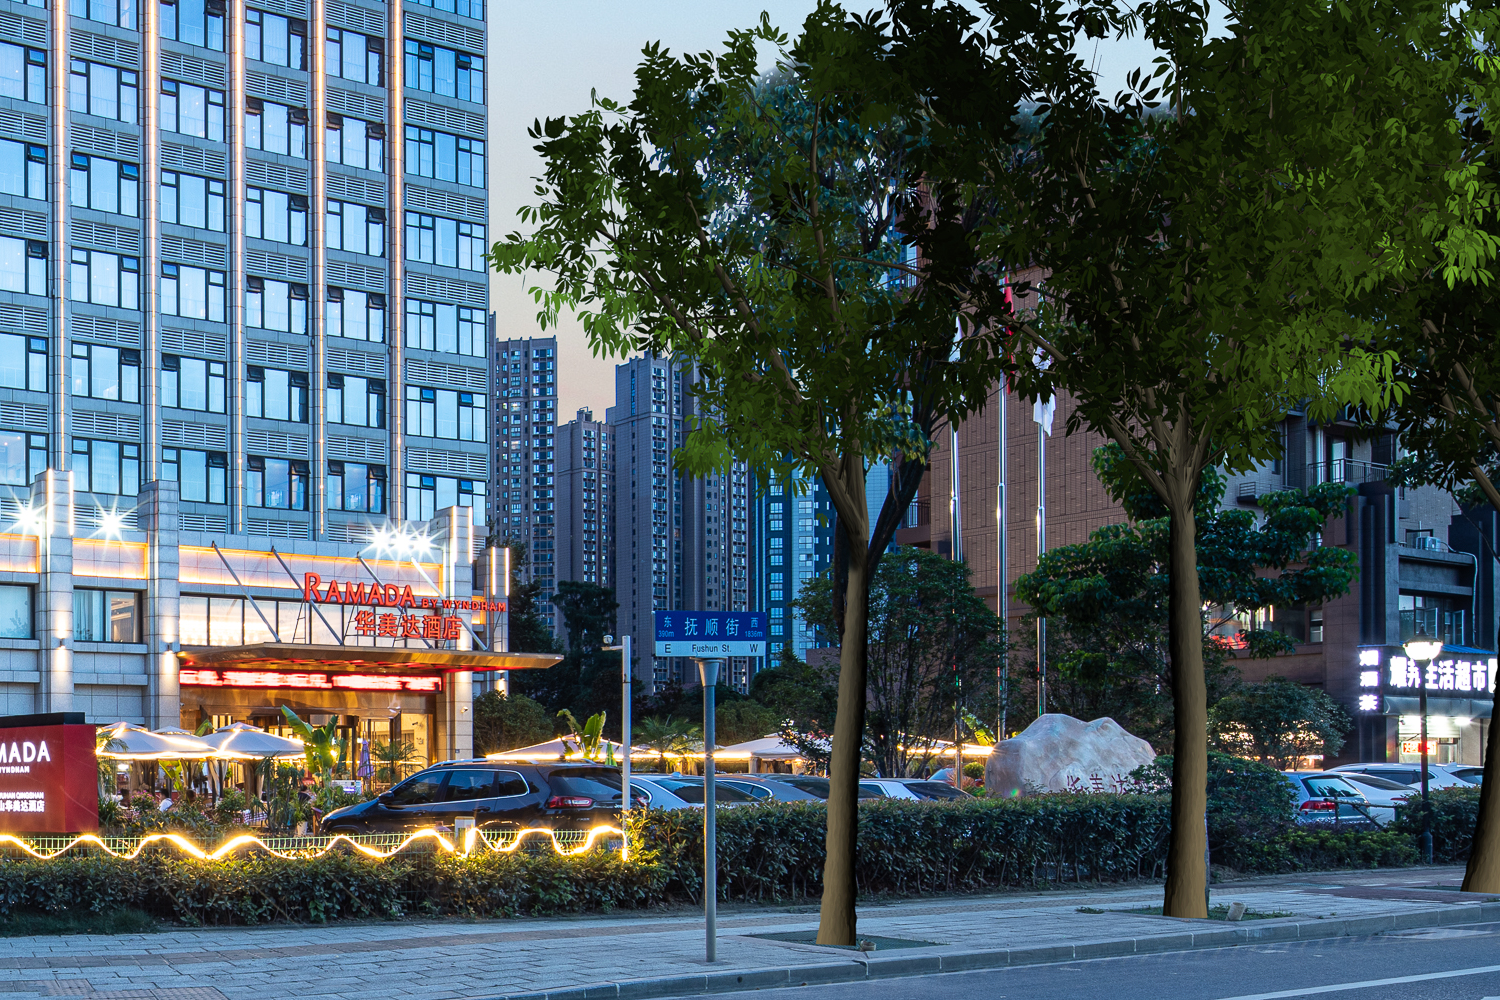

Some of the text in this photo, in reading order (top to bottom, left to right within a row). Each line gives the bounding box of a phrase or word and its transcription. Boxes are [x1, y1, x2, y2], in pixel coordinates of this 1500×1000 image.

[304, 572, 506, 612] RAMADA BY WYNDHAM
[355, 610, 463, 639] 华美达酒店
[664, 615, 672, 628] 东
[684, 617, 740, 637] 抚顺街
[750, 617, 759, 628] 西
[664, 643, 672, 654] E
[691, 644, 732, 653] Fushun St.
[749, 643, 759, 653] W
